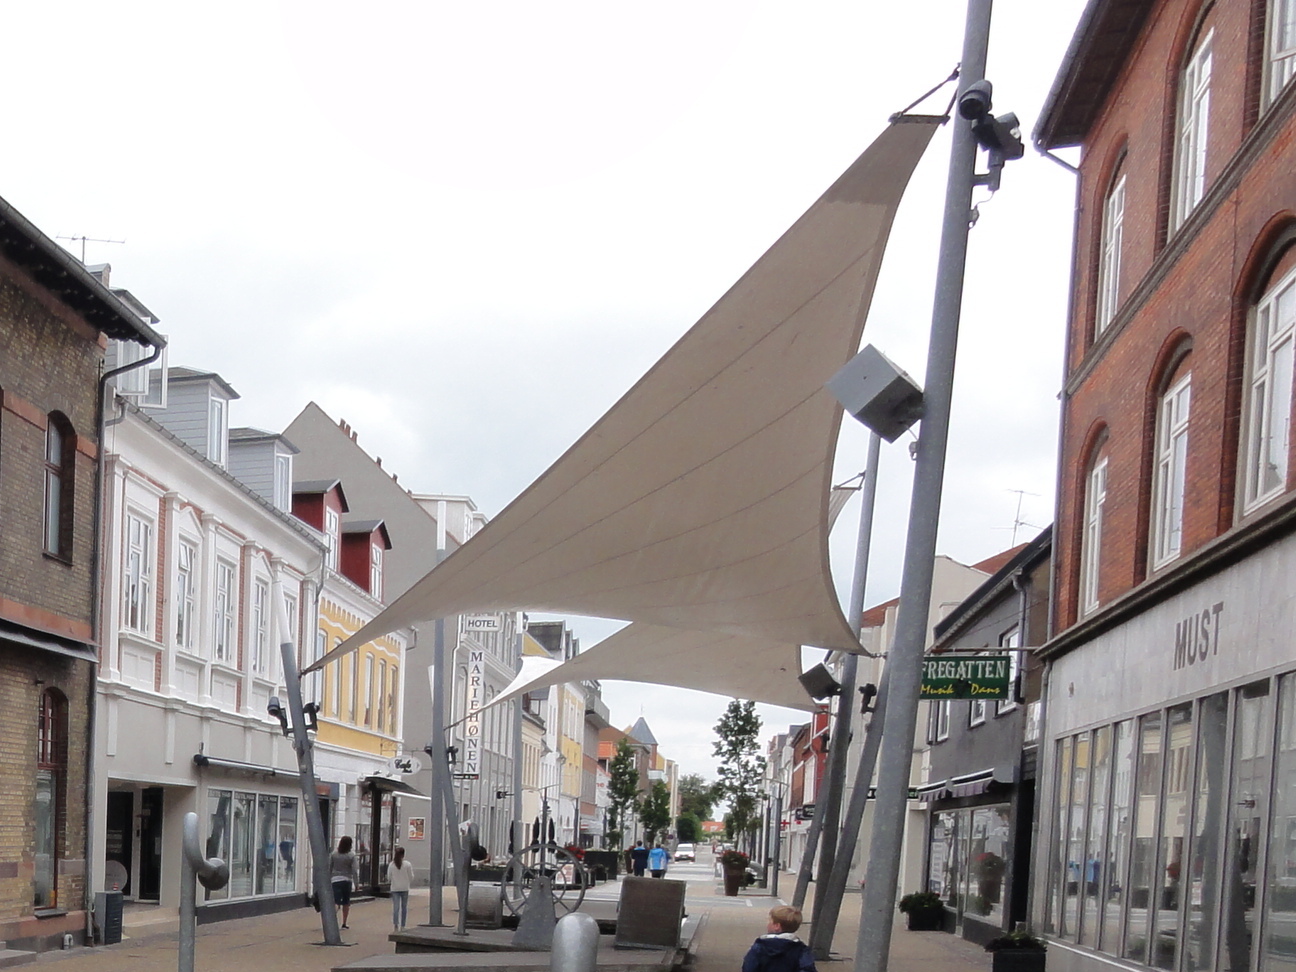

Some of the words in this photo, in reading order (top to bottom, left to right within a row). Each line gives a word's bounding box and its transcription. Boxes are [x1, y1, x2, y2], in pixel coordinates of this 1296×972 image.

[467, 619, 498, 628] HOTEL
[1173, 601, 1224, 671] MUST
[970, 683, 1001, 695] Dans
[466, 651, 483, 773] MARIEHØNEN
